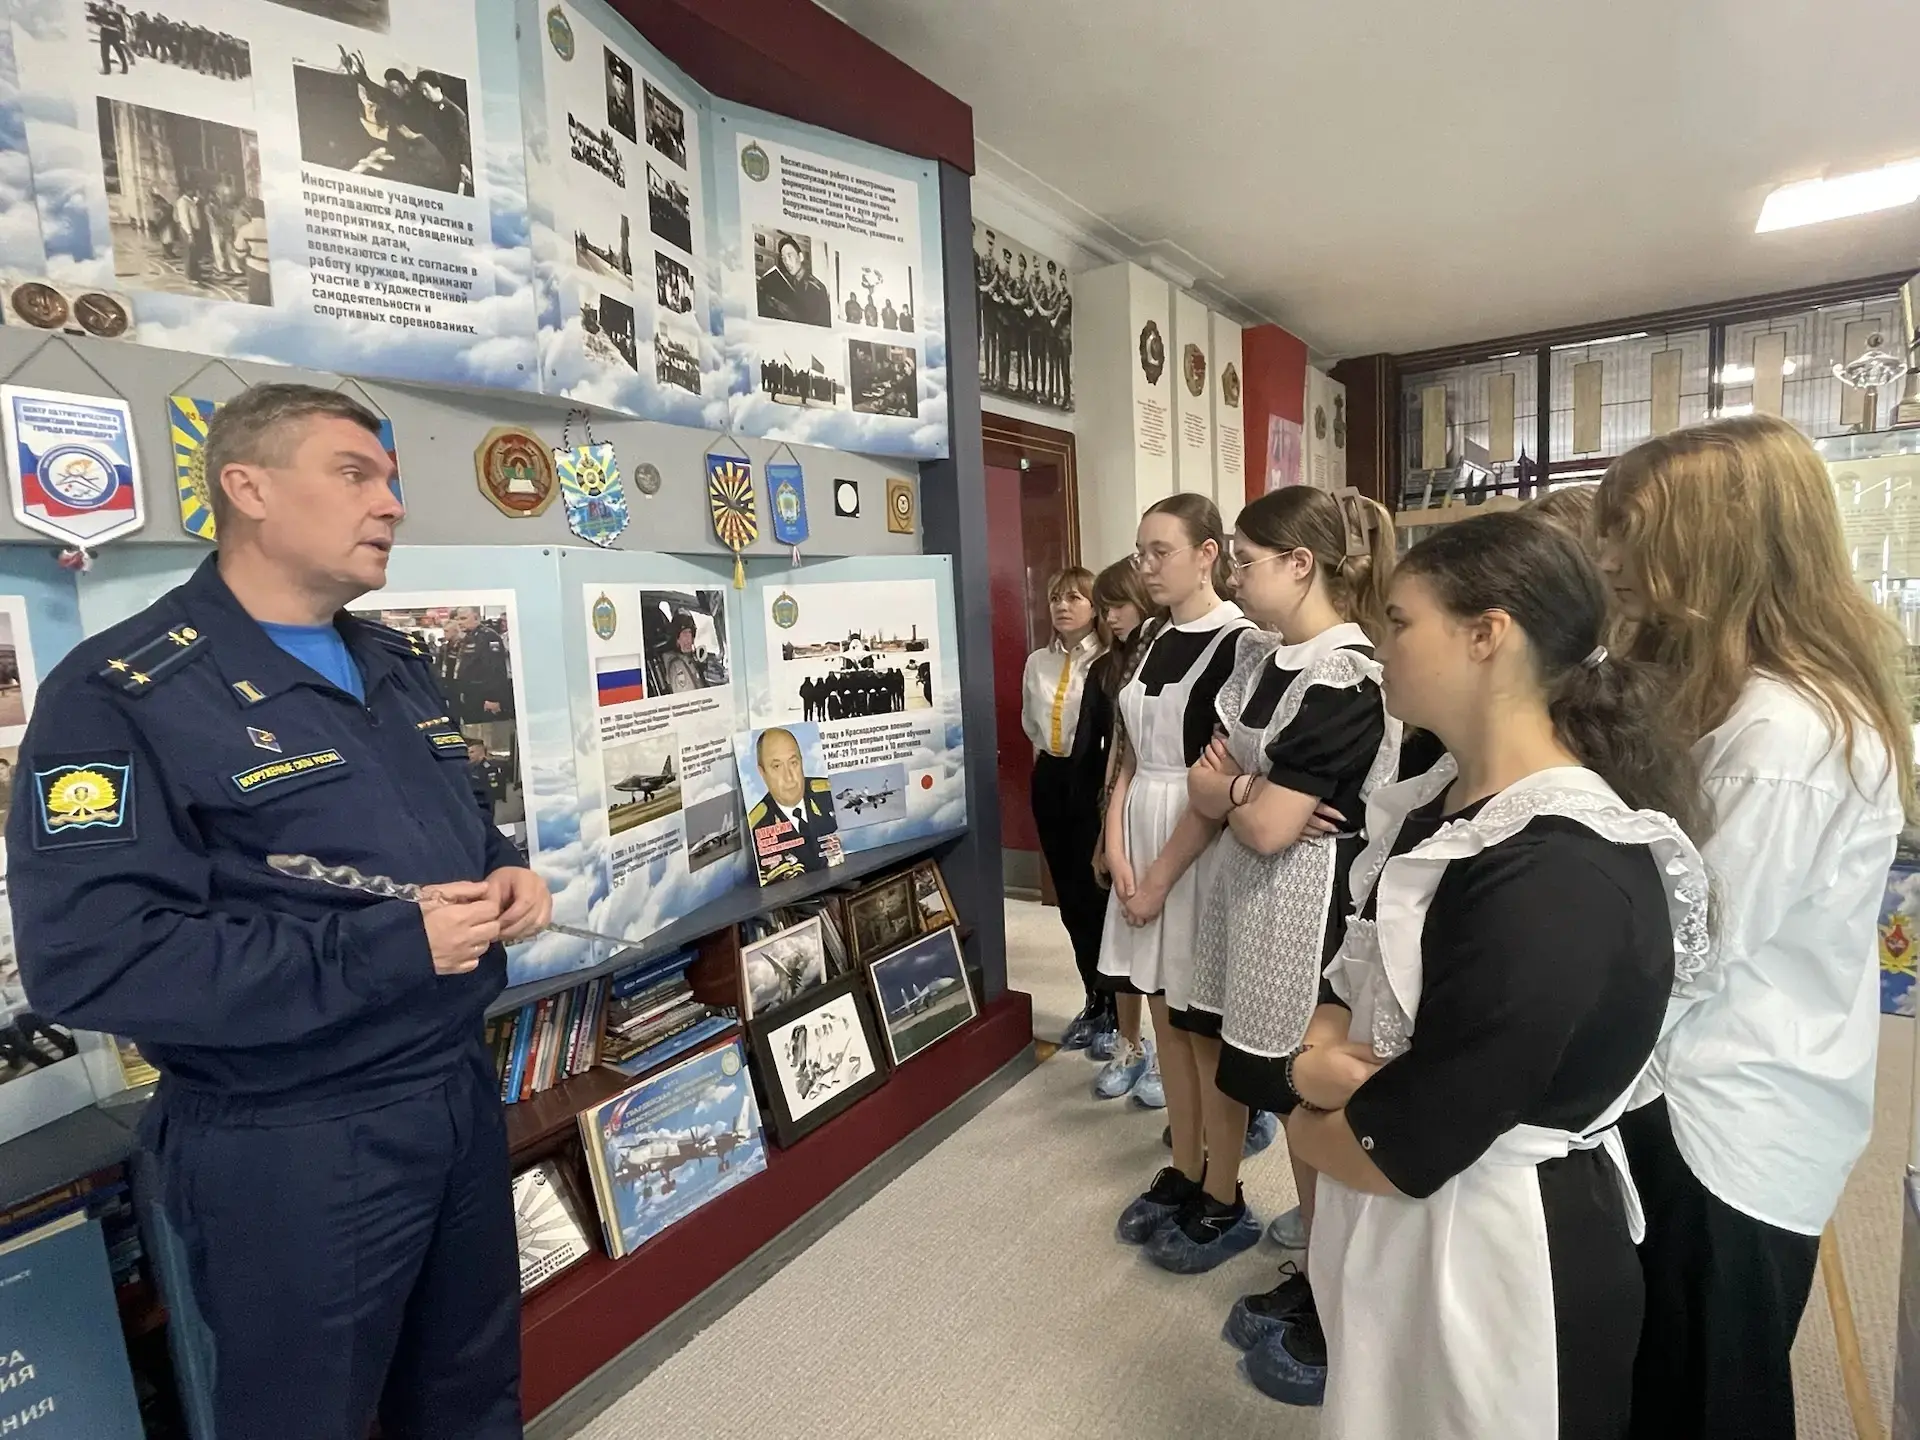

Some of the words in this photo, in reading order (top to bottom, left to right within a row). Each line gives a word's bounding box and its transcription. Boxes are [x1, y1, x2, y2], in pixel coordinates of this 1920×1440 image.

[780, 155, 828, 175] Воспитательная
[829, 170, 849, 182] работа
[855, 178, 895, 193] иностранными
[301, 171, 384, 199] Иностранные
[387, 190, 444, 211] учащиеся
[781, 177, 826, 195] формирования
[833, 191, 843, 199] них
[845, 194, 868, 206] высоких
[303, 190, 391, 216] приглашаются
[394, 208, 416, 221] для
[420, 213, 464, 231] участия
[467, 222, 474, 232] в
[782, 197, 824, 214] Вооруженным
[826, 207, 843, 219] Силам
[845, 212, 877, 227] Российской
[809, 195, 843, 209] воспитания
[857, 206, 870, 218] духе
[872, 209, 894, 222] дружбы
[820, 218, 845, 229] народам
[305, 206, 395, 234] мероприятиях,
[398, 224, 475, 247] посвященных
[306, 223, 368, 242] памятным
[371, 235, 410, 252] датам,
[308, 239, 387, 261] вовлекаются
[391, 254, 398, 262] с
[401, 256, 415, 266] их
[418, 258, 468, 275] согласия
[471, 266, 478, 276] в
[309, 255, 351, 274] работу
[355, 262, 409, 281] кружков,
[412, 272, 473, 290] принимают
[310, 272, 360, 288] участие
[364, 280, 371, 289] в
[374, 281, 468, 304] художественной
[312, 287, 421, 313] самодеятельности
[424, 304, 432, 313] и
[313, 304, 385, 323] спортивных
[389, 313, 478, 335] соревнованиях.
[826, 731, 839, 741] году
[845, 725, 889, 738] Краснодарском
[890, 722, 913, 731] военном
[831, 738, 859, 749] институте
[860, 735, 884, 746] впервые
[885, 731, 905, 742] прошли
[906, 728, 931, 739] обучение
[827, 759, 859, 771] Бангладеш
[870, 754, 892, 763] летчика
[850, 748, 858, 756] 70
[859, 745, 884, 755] техников
[890, 741, 896, 750] 10
[897, 739, 921, 749] летчиков
[0, 1396, 55, 1438] НИЯ
